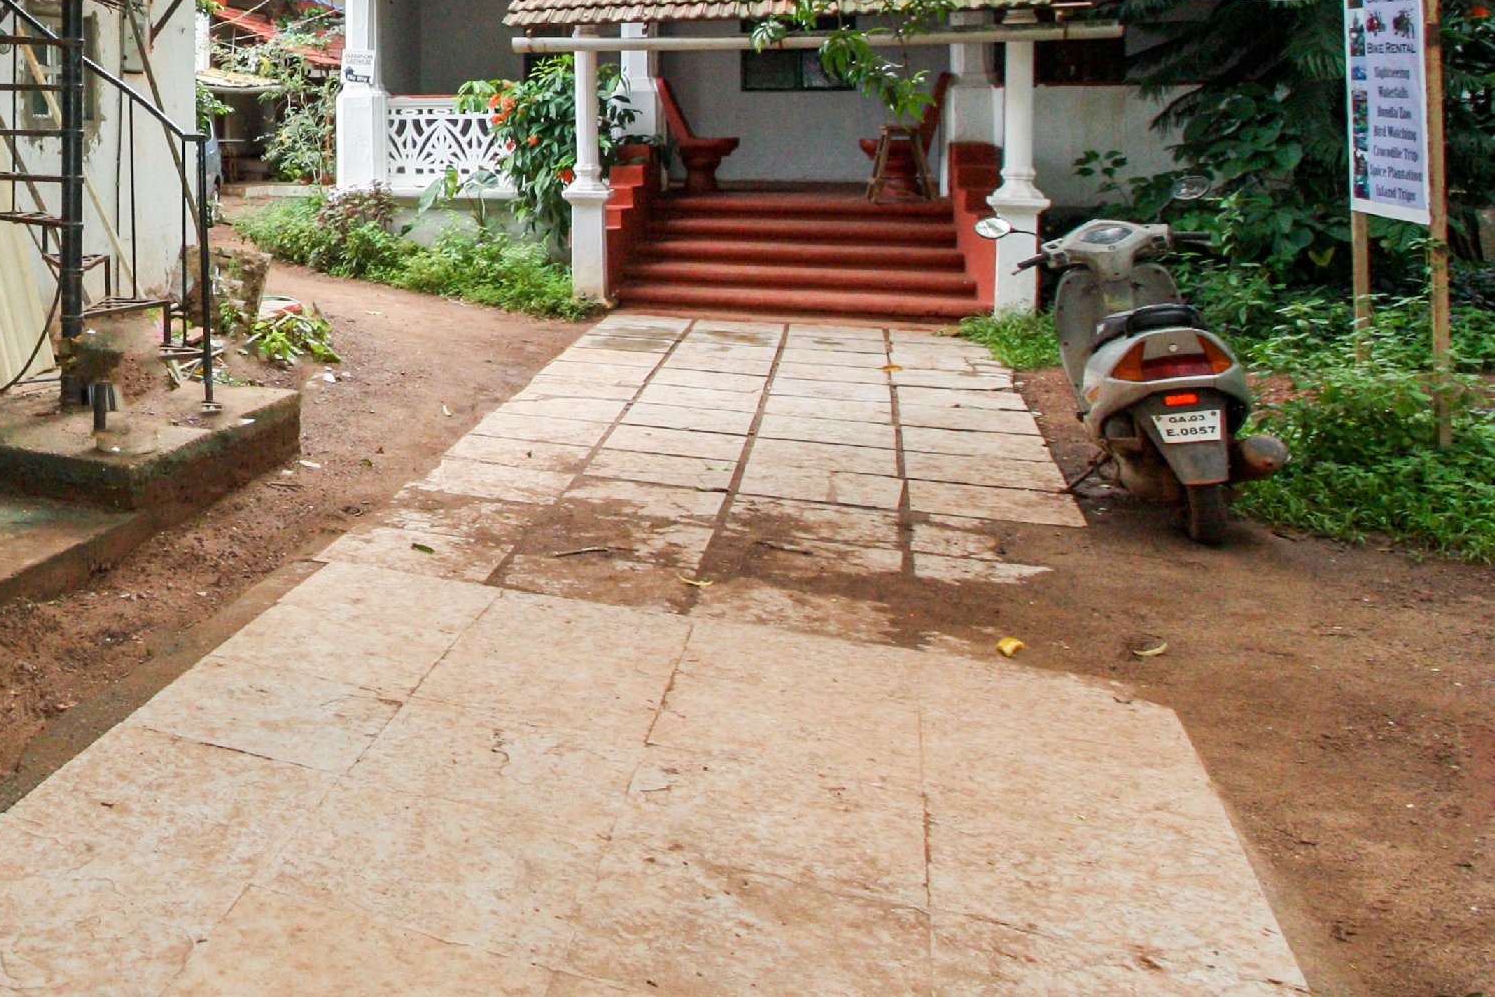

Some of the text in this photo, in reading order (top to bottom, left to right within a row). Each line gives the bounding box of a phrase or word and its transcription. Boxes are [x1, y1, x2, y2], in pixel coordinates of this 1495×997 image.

[1367, 42, 1416, 53] BIKE RENTAL
[1374, 125, 1416, 142] Bird Watching
[1370, 164, 1423, 182] Spice Plantation
